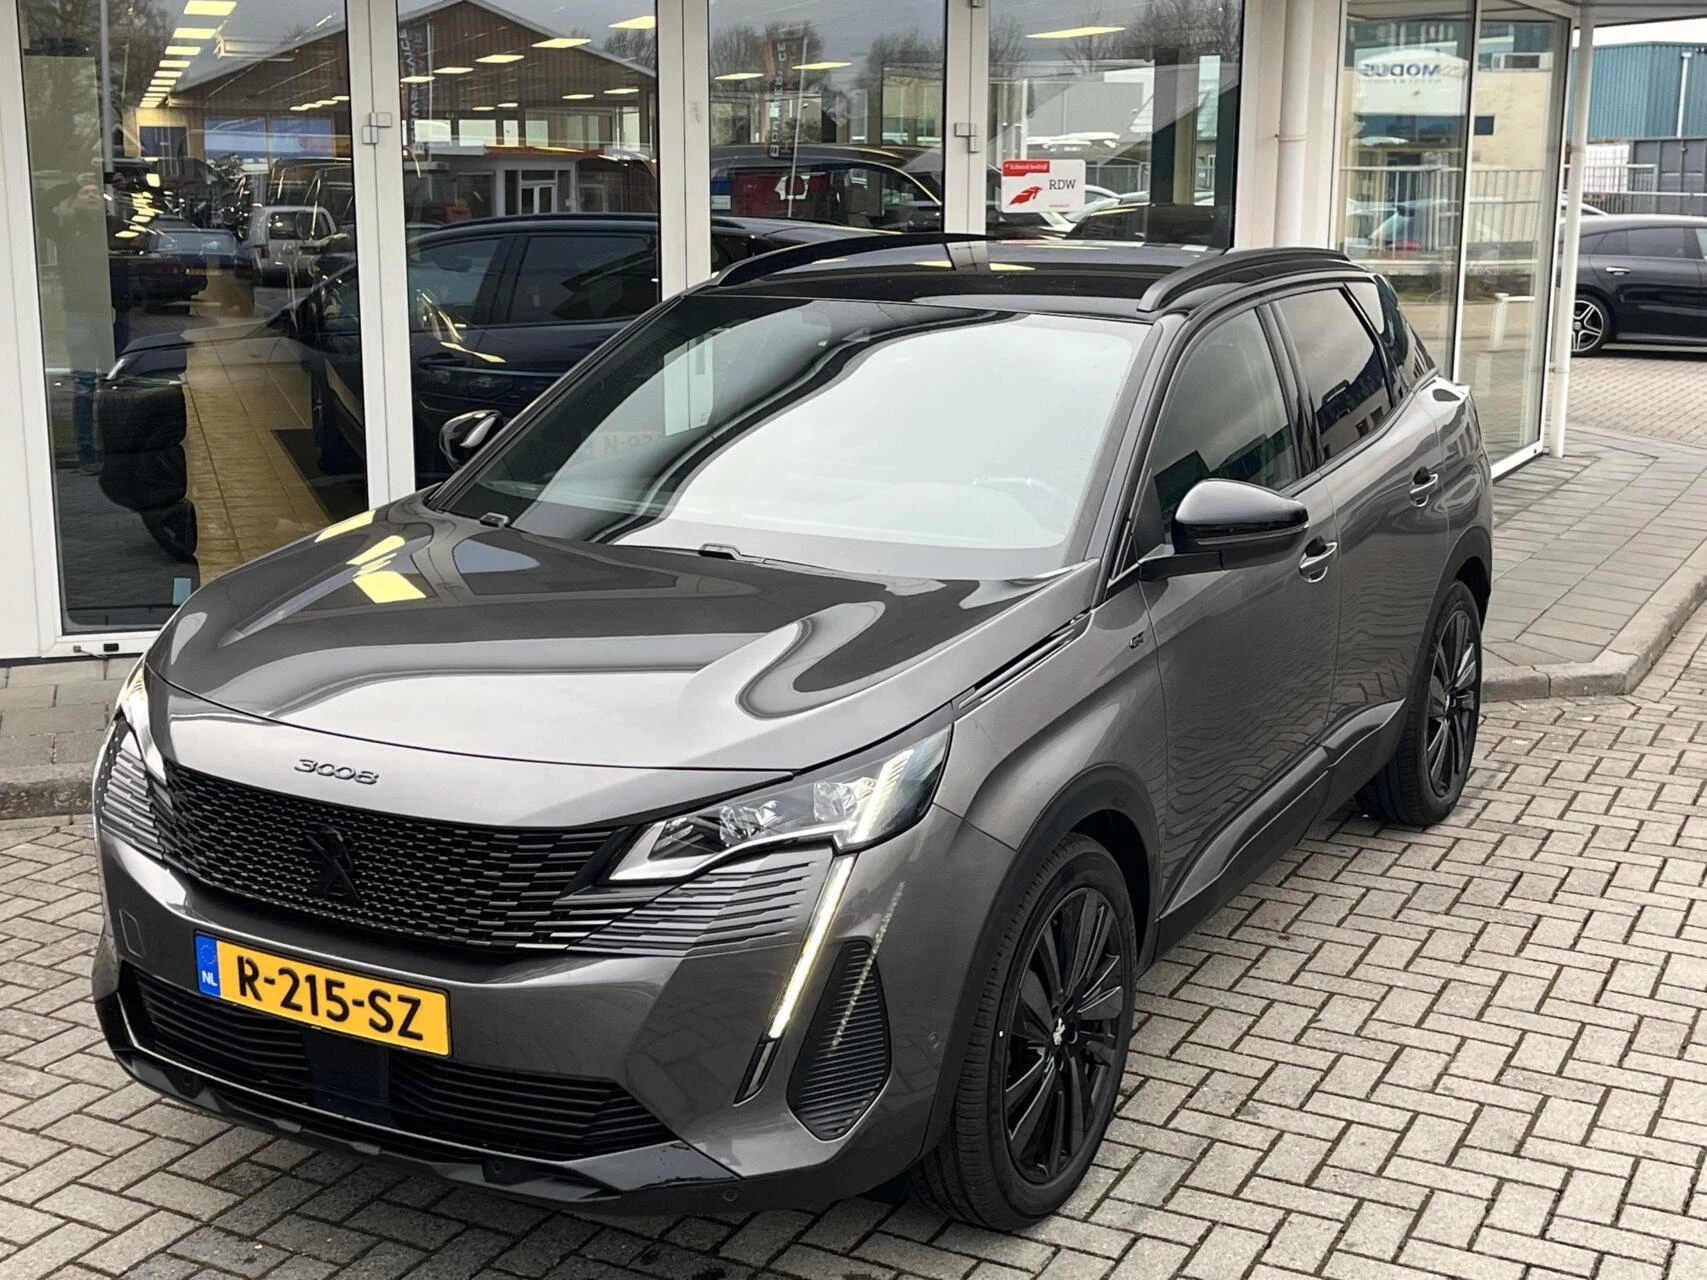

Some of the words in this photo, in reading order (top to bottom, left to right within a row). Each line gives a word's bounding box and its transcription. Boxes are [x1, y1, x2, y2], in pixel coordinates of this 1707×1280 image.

[1049, 179, 1077, 190] RDW
[294, 759, 380, 785] 3008
[201, 969, 218, 987] NL
[237, 955, 423, 1041] R-215-SZ
